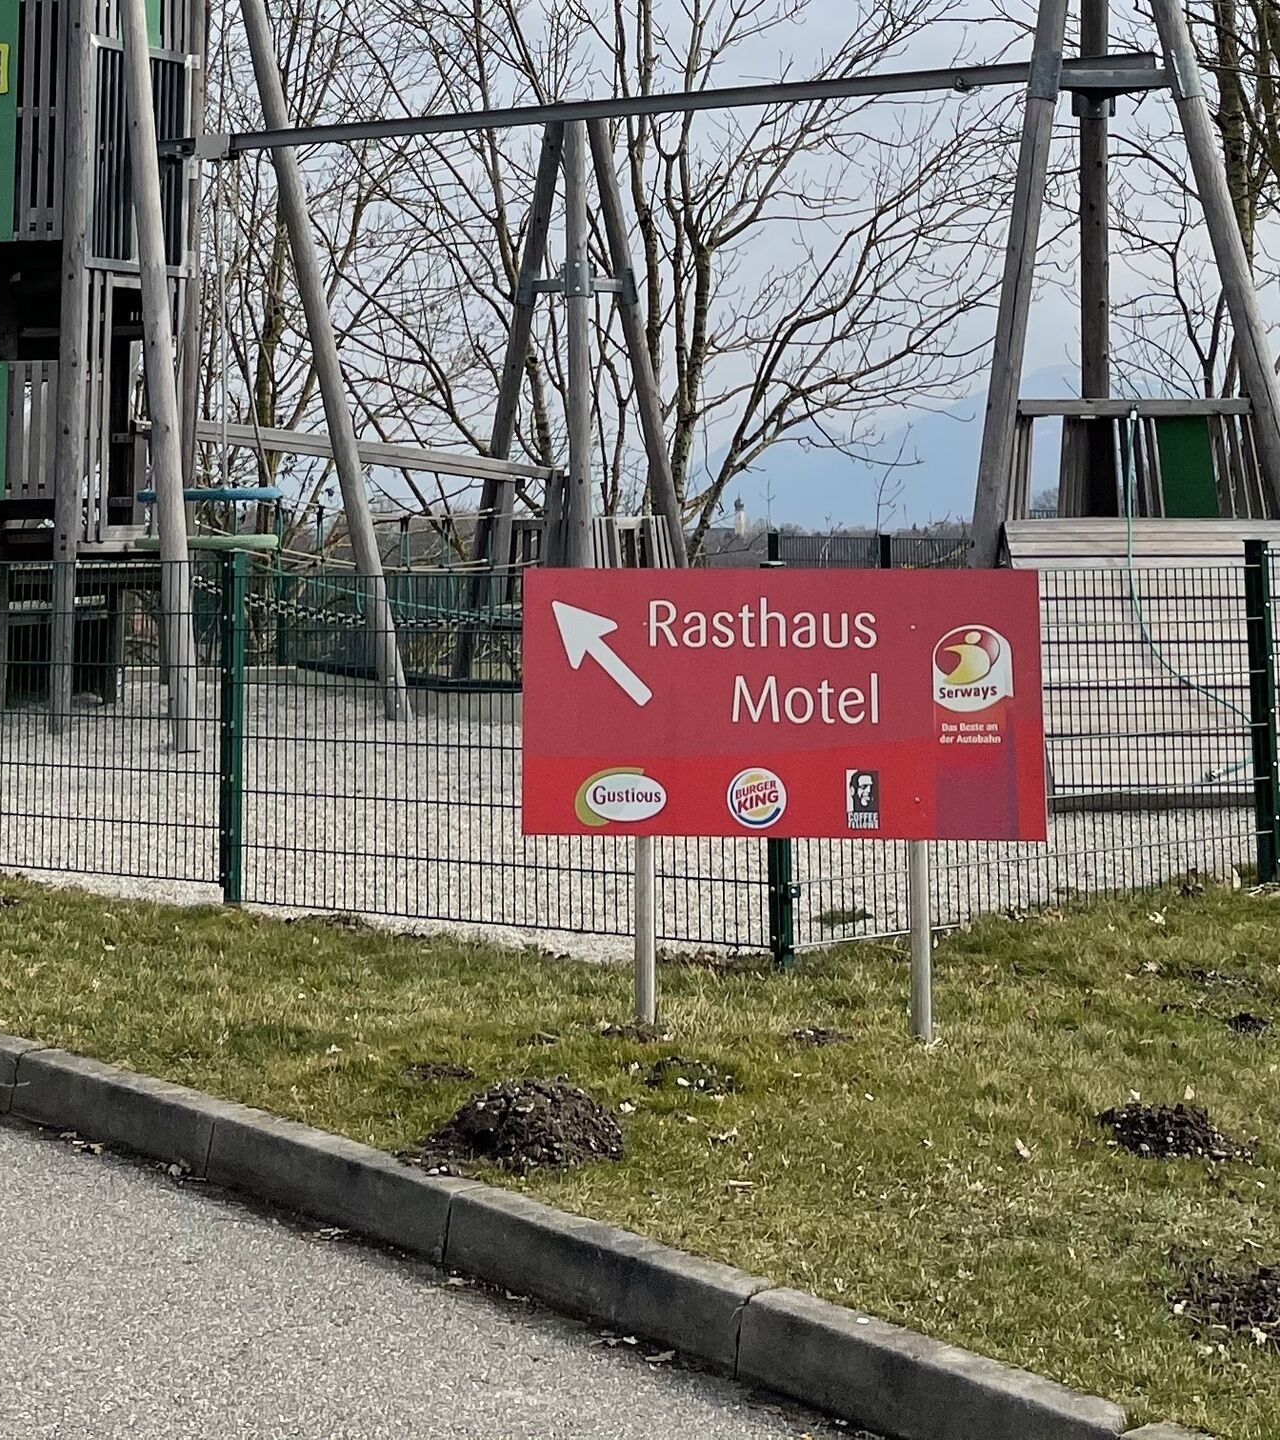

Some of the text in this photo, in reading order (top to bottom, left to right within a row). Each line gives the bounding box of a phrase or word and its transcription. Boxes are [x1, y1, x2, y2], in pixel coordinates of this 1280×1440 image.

[648, 597, 879, 649] Rasthaus
[731, 672, 880, 724] Motel
[939, 686, 998, 700] Serways
[941, 723, 958, 731] Das
[960, 723, 984, 731] Beste
[939, 734, 1002, 744] der Autobahn
[592, 785, 662, 805] Gustious
[735, 780, 776, 800] BURGER
[737, 790, 779, 814] KING
[847, 812, 879, 821] COFFEE
